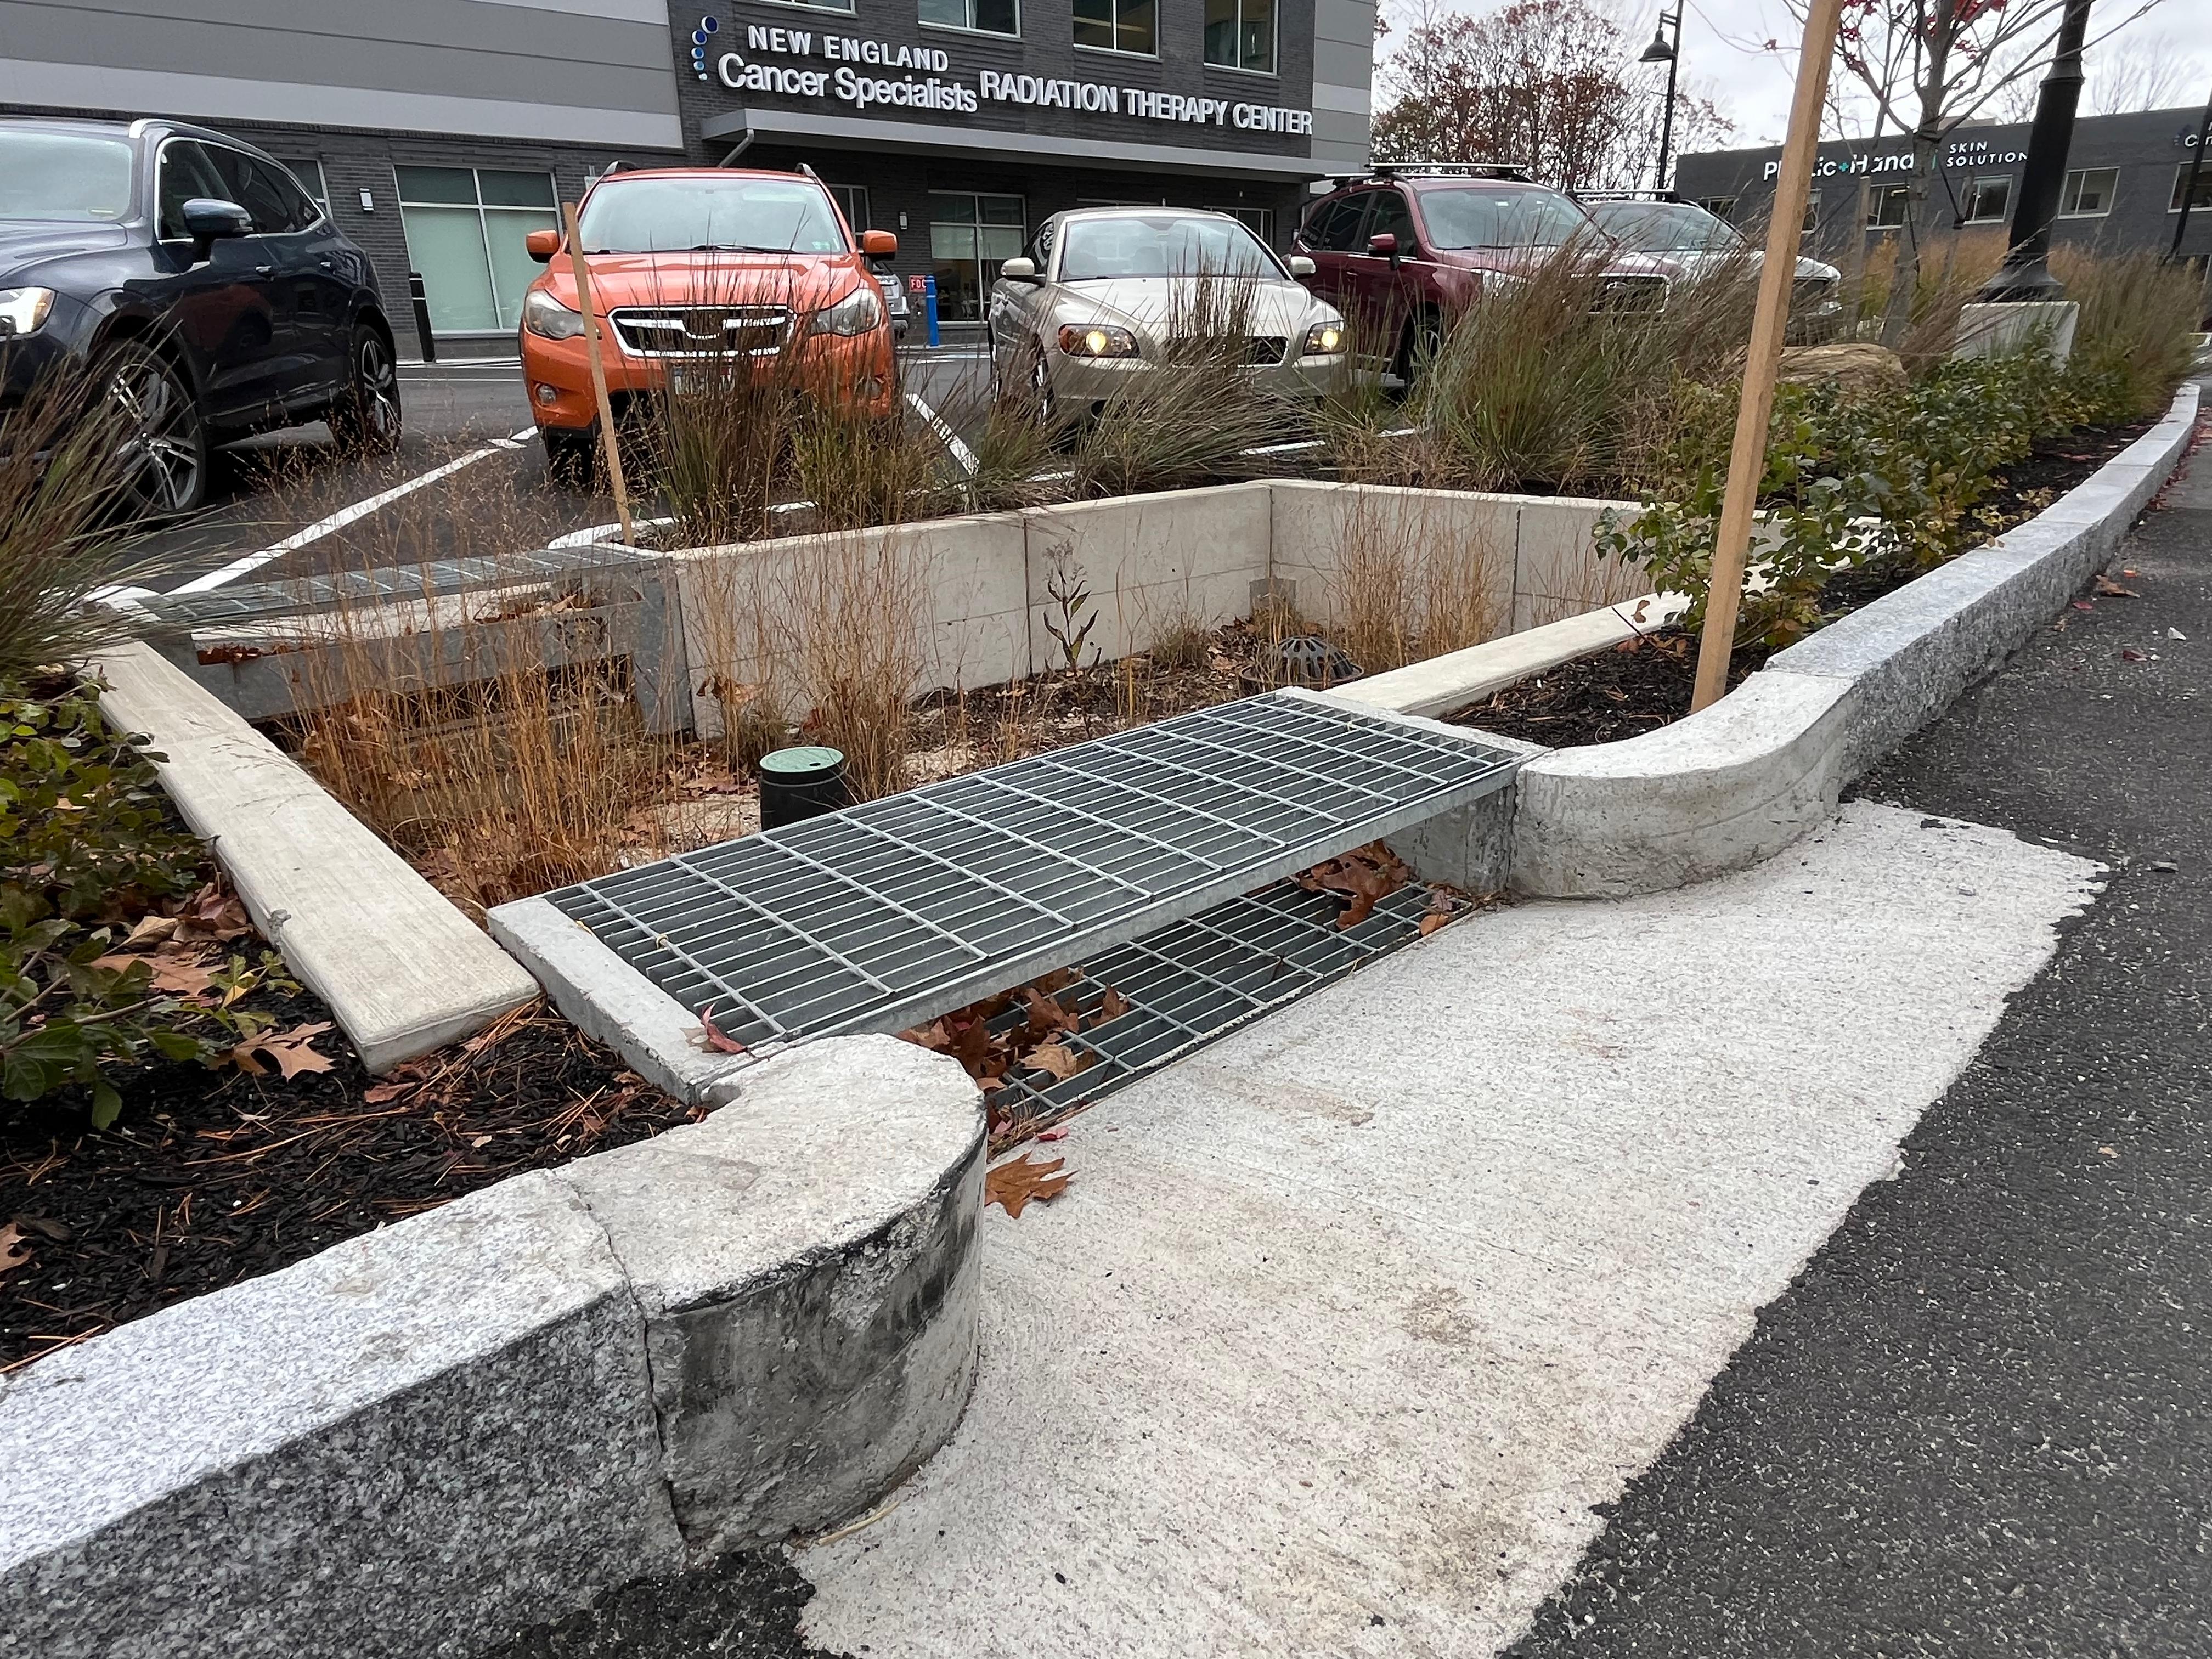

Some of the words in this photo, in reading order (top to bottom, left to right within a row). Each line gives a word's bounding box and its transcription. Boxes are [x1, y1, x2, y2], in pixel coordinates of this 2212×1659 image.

[748, 25, 811, 55] NEW
[825, 35, 949, 72] ENGLAND
[718, 53, 829, 97] Cancer
[834, 66, 978, 112] Specialists
[980, 71, 1118, 113] RADIATION
[1123, 88, 1228, 126] THERAPY
[1232, 103, 1312, 135] CENTER
[1950, 141, 1988, 154] SKIN
